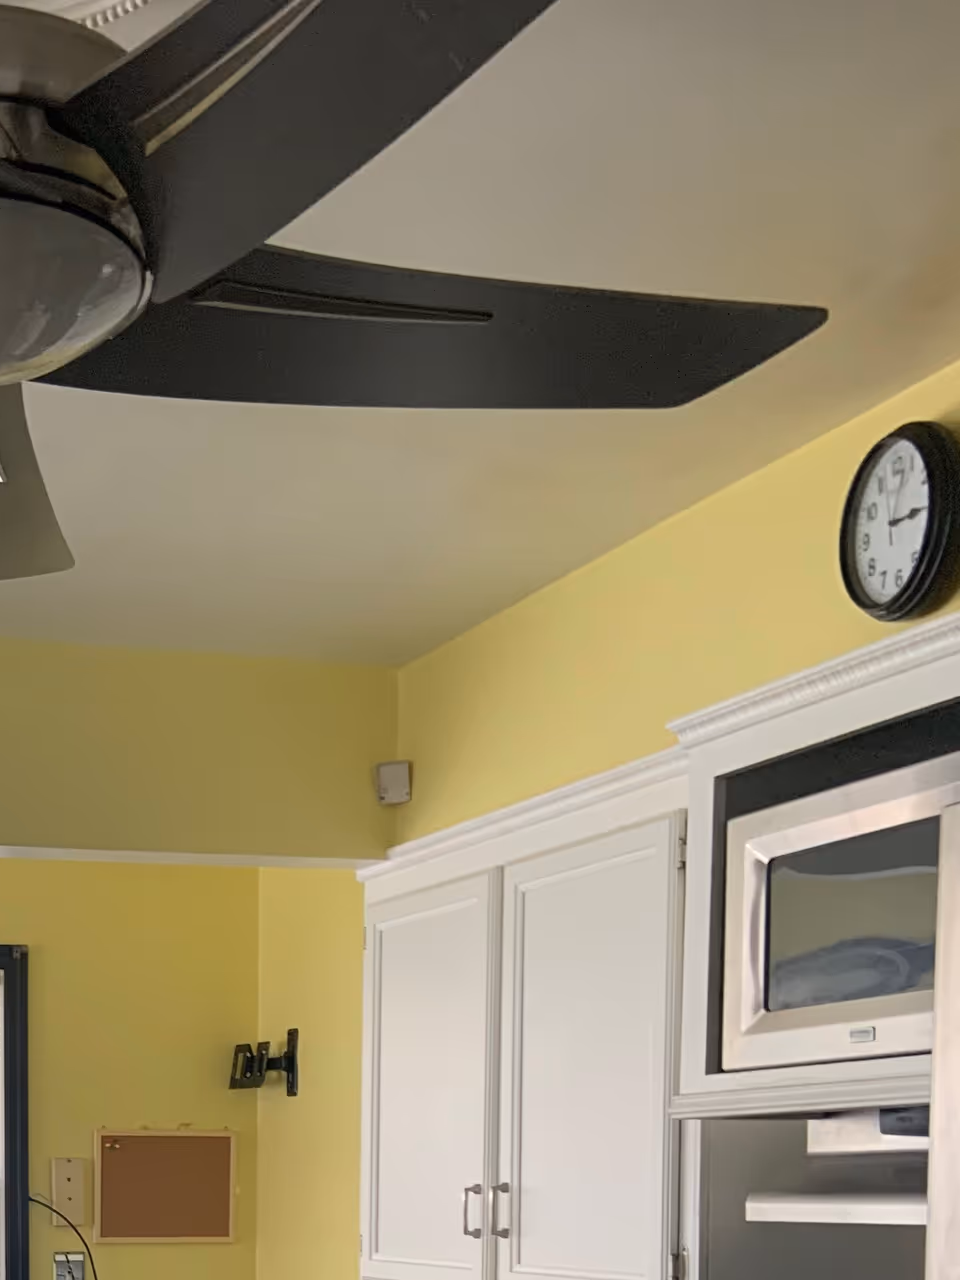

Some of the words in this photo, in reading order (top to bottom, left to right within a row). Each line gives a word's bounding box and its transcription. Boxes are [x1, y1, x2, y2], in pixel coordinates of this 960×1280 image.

[866, 502, 878, 521] 10
[862, 533, 870, 552] 9
[868, 557, 876, 577] 8
[879, 570, 888, 590] 7
[894, 568, 903, 588] 6
